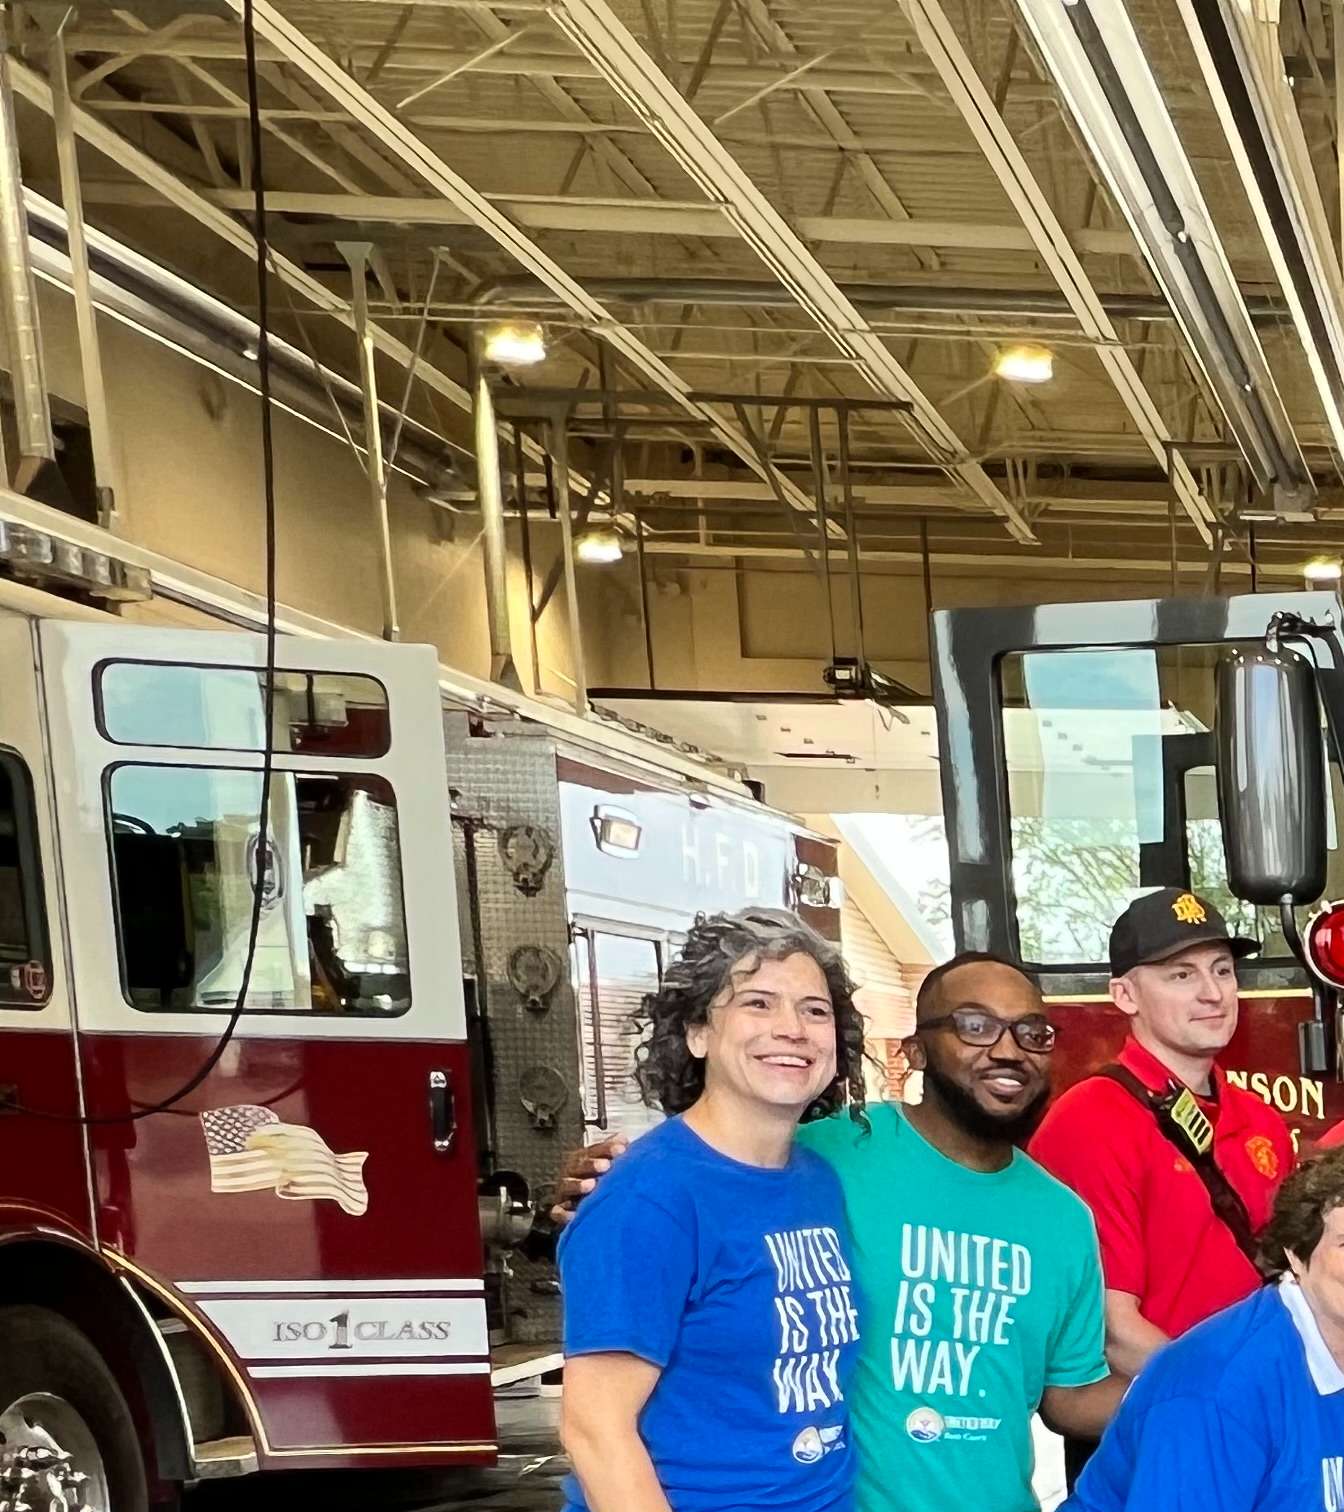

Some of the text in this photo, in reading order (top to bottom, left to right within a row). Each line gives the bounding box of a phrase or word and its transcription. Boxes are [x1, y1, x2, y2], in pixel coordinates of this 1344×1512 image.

[764, 1226, 852, 1293] UNITED
[901, 1223, 1032, 1296] UNITED
[272, 1308, 451, 1350] ISO 1 CLASS
[774, 1286, 861, 1354] IS THE
[893, 1280, 1017, 1345] IS THE
[890, 1337, 987, 1398] WAY.
